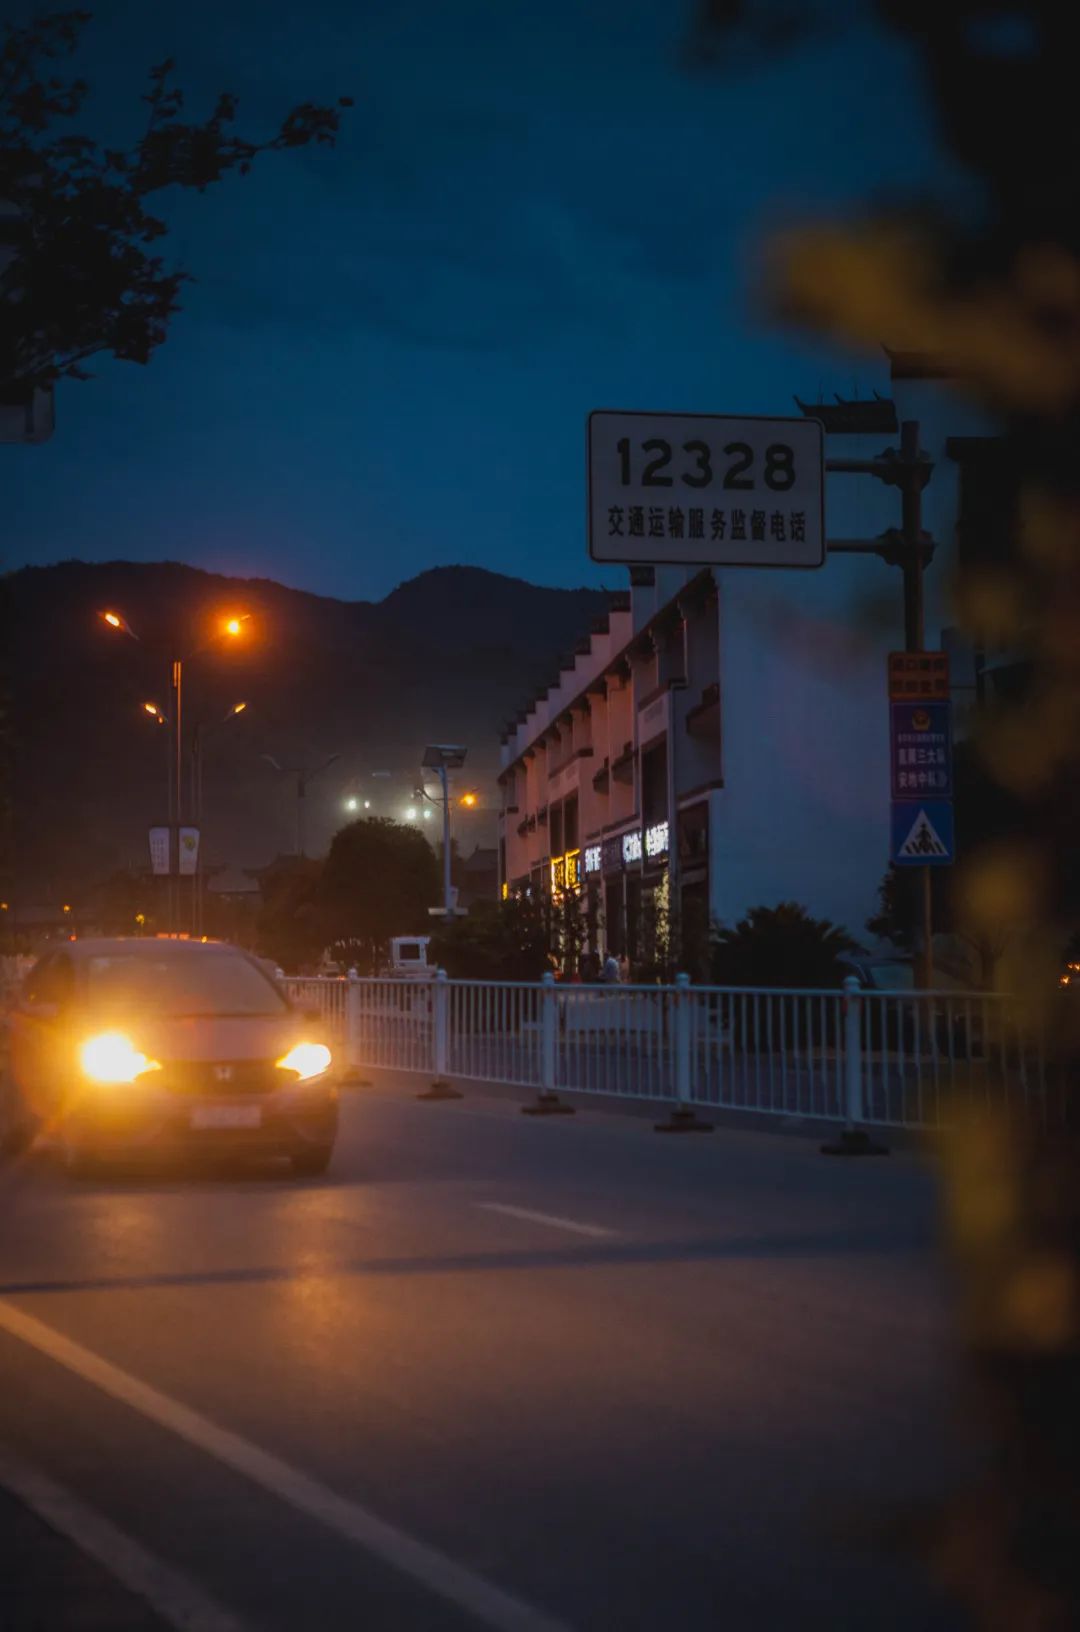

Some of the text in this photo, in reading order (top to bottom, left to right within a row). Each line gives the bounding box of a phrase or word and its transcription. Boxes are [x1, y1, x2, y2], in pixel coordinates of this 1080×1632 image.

[617, 437, 796, 492] 12328
[608, 505, 807, 542] 交通运输服务监督电话
